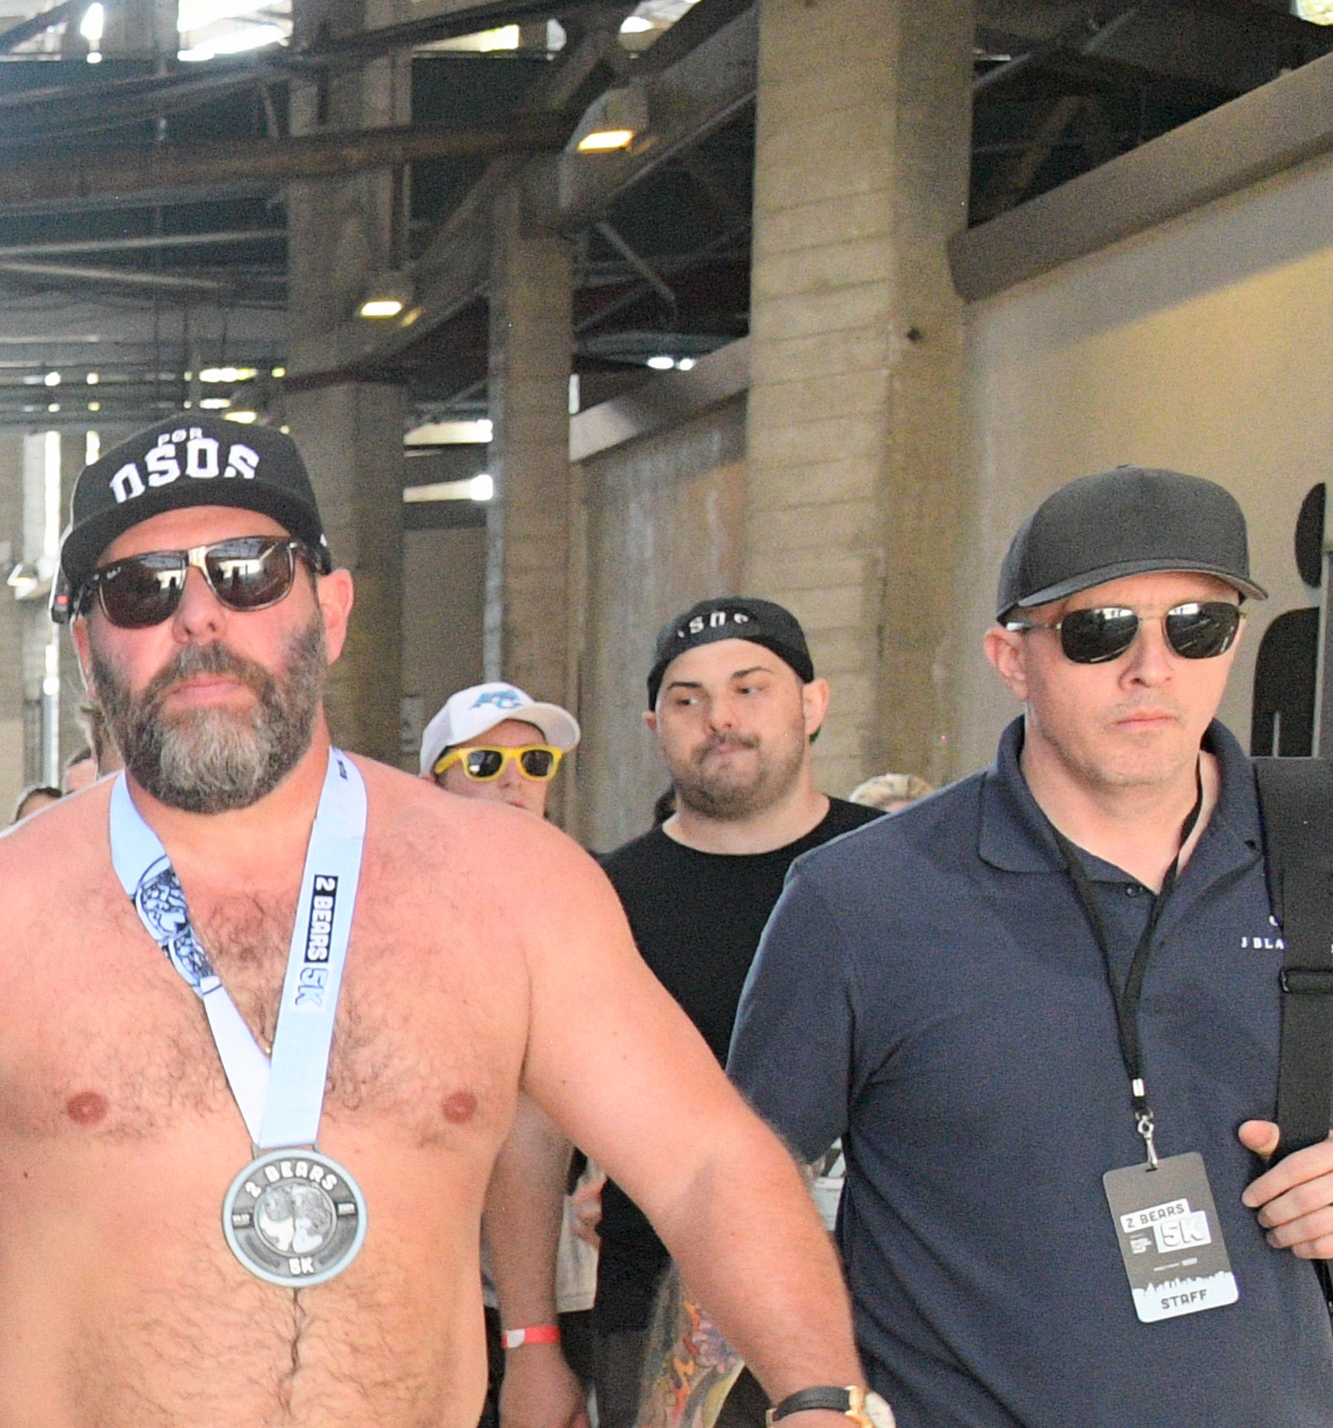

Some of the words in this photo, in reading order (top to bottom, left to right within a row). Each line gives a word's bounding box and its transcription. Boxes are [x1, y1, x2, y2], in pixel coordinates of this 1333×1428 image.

[315, 877, 336, 893] 2
[307, 895, 334, 962] BEARS
[1253, 936, 1285, 951] BLA
[295, 966, 330, 1007] 5K
[244, 1181, 262, 1198] 2
[264, 1160, 338, 1191] BEARS
[1126, 1217, 1135, 1229] 2
[1139, 1203, 1185, 1225] BEARS
[1159, 1219, 1205, 1248] 5K
[288, 1256, 315, 1276] 5K
[1160, 1288, 1208, 1310] STAFF
